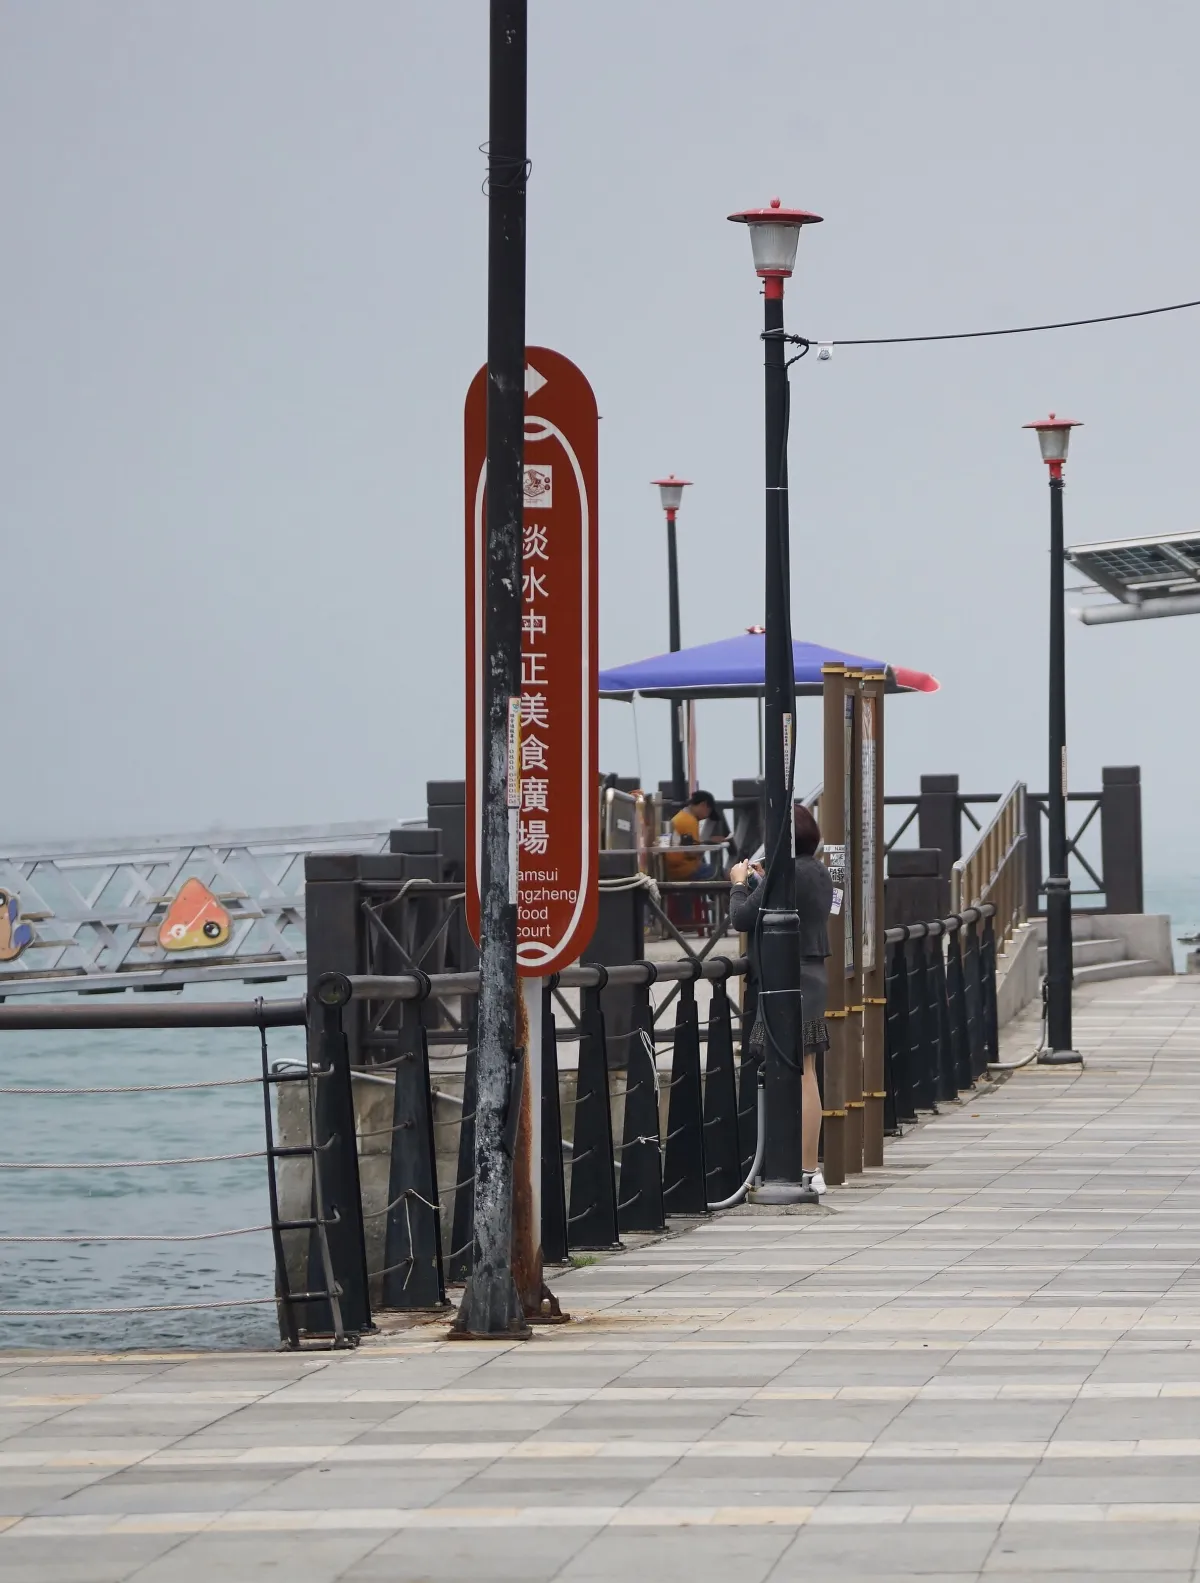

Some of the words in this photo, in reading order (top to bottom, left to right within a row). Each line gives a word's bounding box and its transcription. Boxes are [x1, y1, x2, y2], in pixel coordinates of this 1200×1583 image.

[519, 523, 550, 854] 淡水中正美食廣場
[517, 869, 558, 881] amsui
[516, 888, 577, 903] ngzheng
[517, 907, 549, 920] food
[516, 925, 551, 937] court
